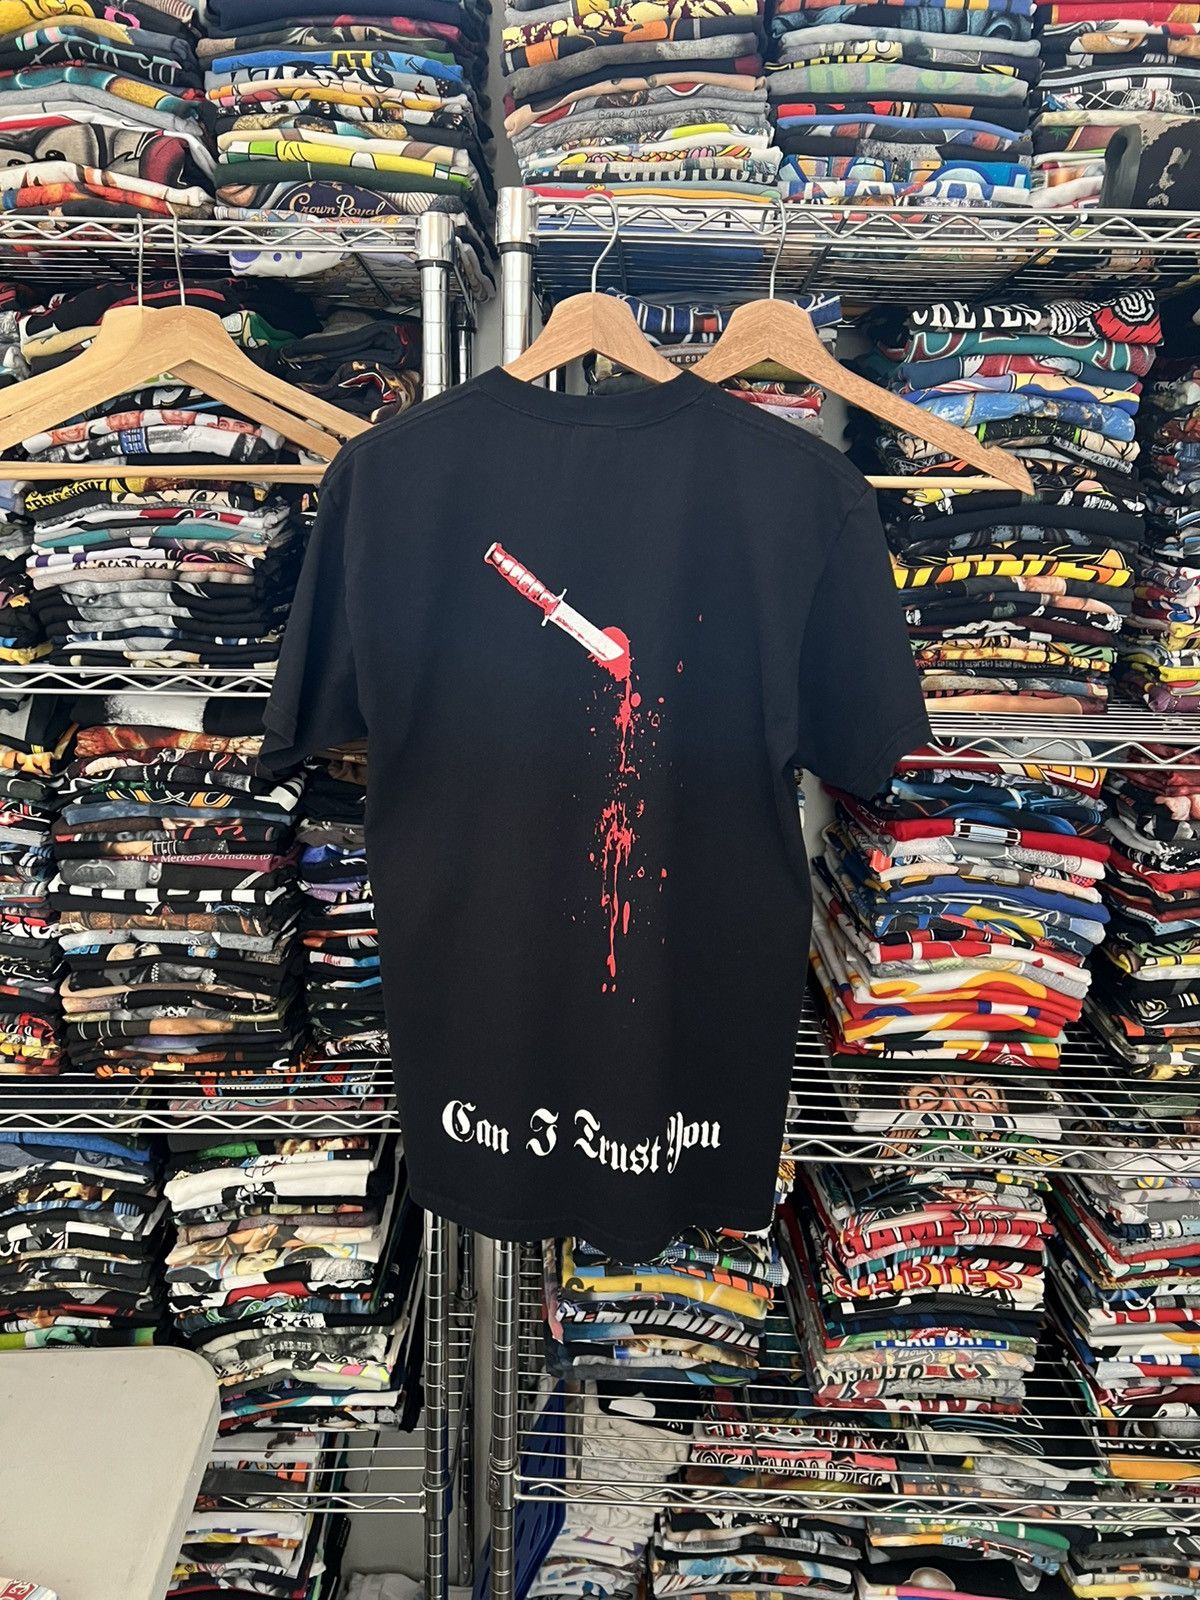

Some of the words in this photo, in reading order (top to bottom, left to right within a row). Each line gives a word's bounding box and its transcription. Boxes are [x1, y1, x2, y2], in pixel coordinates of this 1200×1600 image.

[289, 193, 336, 216] Crown
[336, 195, 386, 218] Royal
[442, 1100, 509, 1155] Can
[526, 1108, 559, 1156] I
[574, 1109, 661, 1175] Trust
[666, 1111, 721, 1174] You
